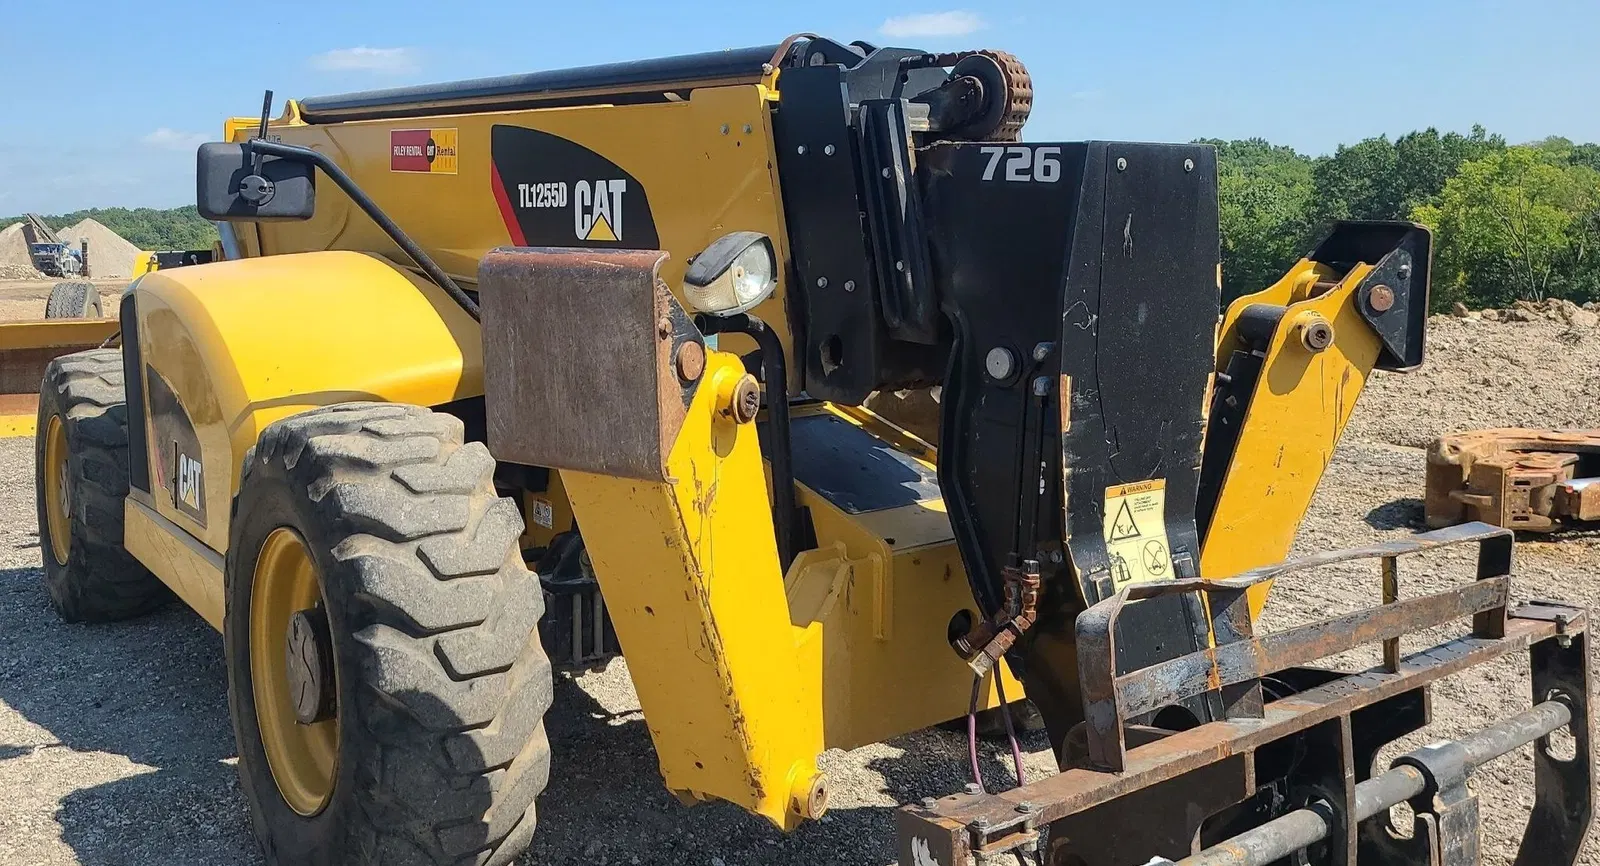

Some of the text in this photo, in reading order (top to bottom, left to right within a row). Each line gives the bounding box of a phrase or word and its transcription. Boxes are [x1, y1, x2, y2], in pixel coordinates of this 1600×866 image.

[393, 145, 406, 156] FOLEY
[406, 145, 423, 156] RENTAL
[436, 145, 456, 156] Rental
[980, 146, 1061, 183] 726
[518, 179, 627, 241] TL1255D CAT
[180, 453, 202, 511] CAT
[1127, 483, 1152, 493] WARNING
